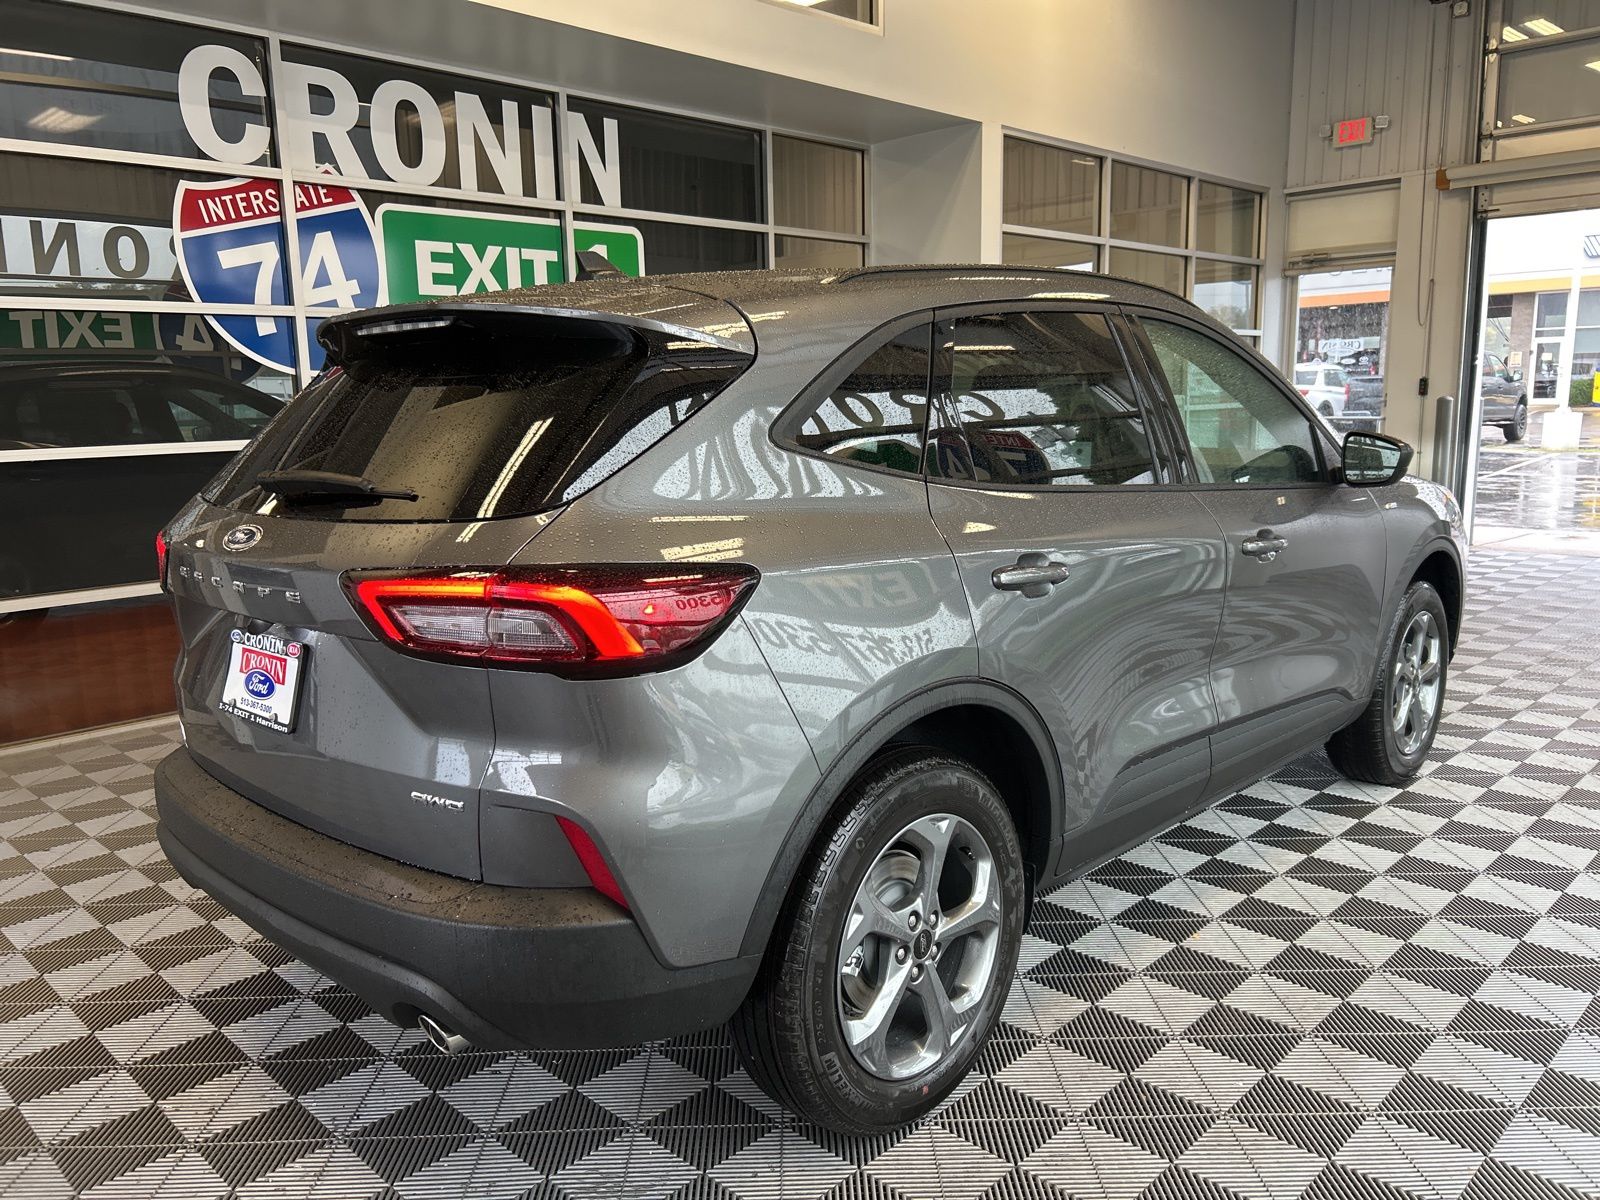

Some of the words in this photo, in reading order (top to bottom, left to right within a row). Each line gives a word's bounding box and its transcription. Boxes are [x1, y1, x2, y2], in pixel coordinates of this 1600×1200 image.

[177, 45, 622, 209] CRONIN
[1339, 118, 1366, 143] EXIT
[198, 184, 333, 224] INTERSATE
[415, 240, 557, 296] EXIT
[217, 231, 361, 337] 74
[244, 632, 284, 654] CRONIN
[243, 651, 286, 685] CRONIN
[249, 674, 270, 694] Ford
[240, 697, 273, 714] 513-367-5300
[234, 708, 250, 720] EXIT
[250, 713, 255, 722] 1
[256, 715, 288, 733] Harrison
